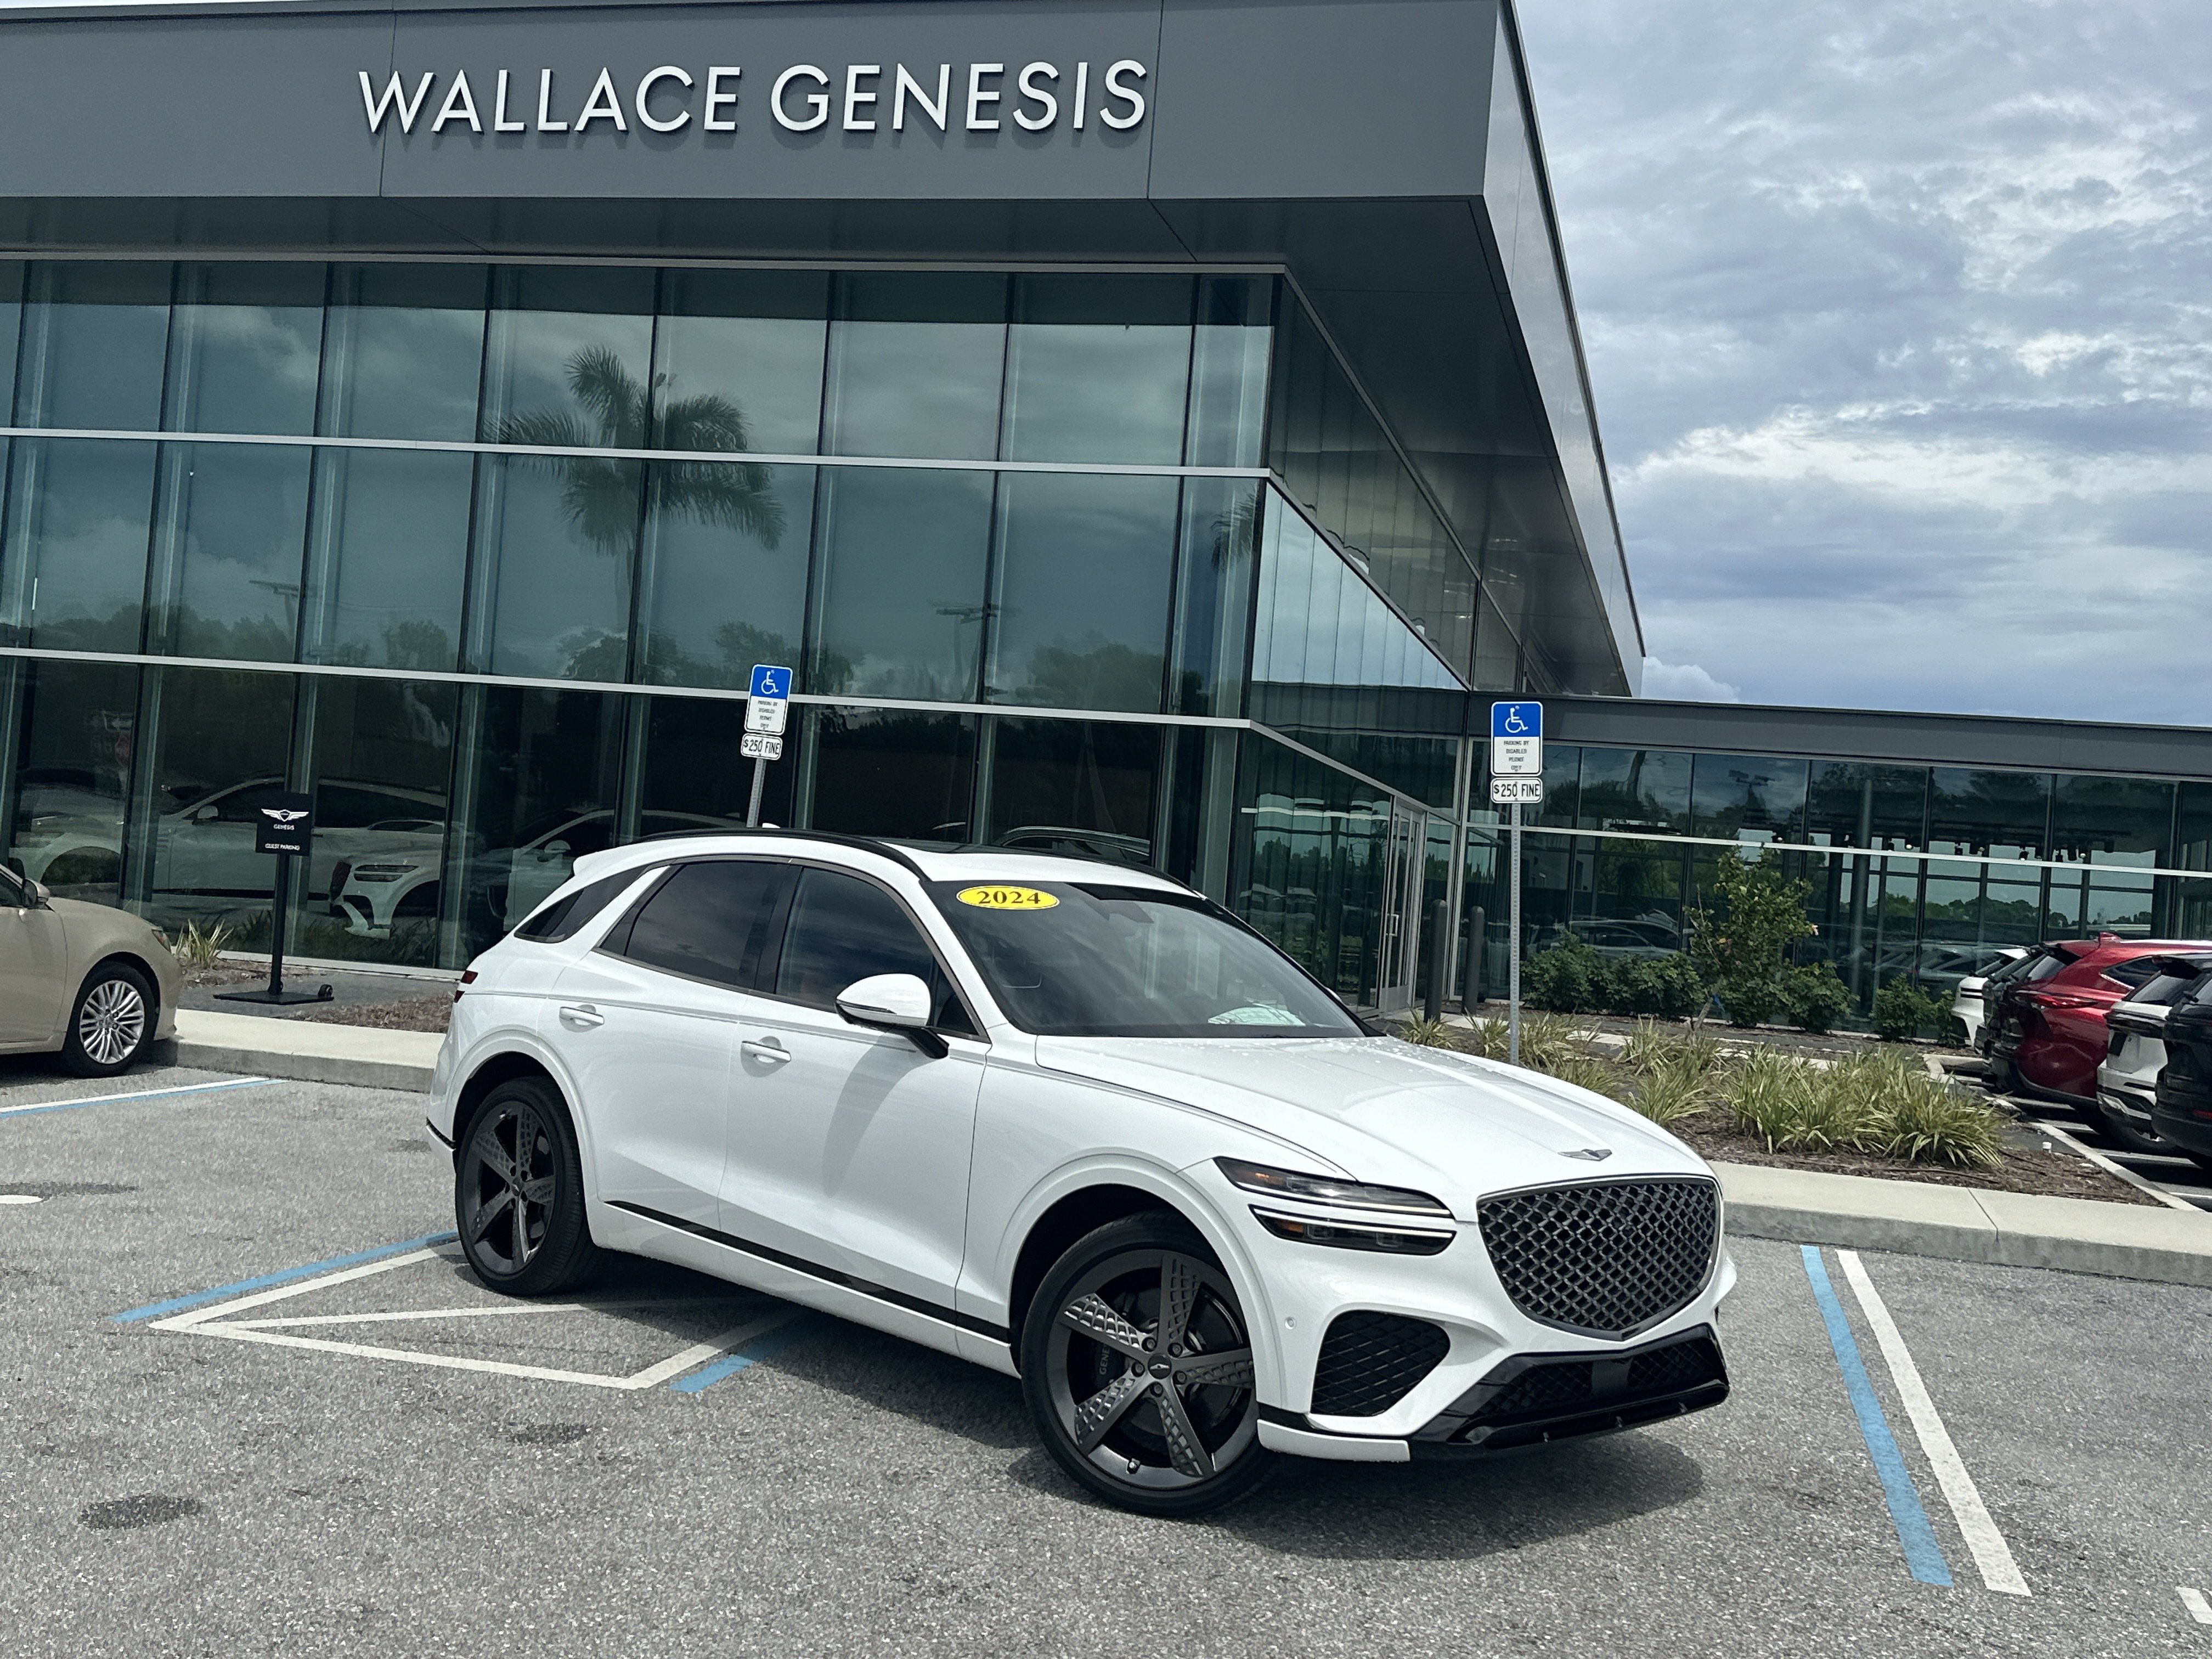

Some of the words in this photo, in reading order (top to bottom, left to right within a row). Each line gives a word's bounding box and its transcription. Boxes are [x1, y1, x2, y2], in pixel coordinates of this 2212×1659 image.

[358, 65, 741, 134] WALLACE
[771, 59, 1147, 131] GENESIS
[743, 738, 763, 752] $250
[764, 742, 780, 755] FINE
[1494, 784, 1517, 797] $250
[1521, 784, 1540, 797] FINE
[977, 891, 1041, 904] 2024
